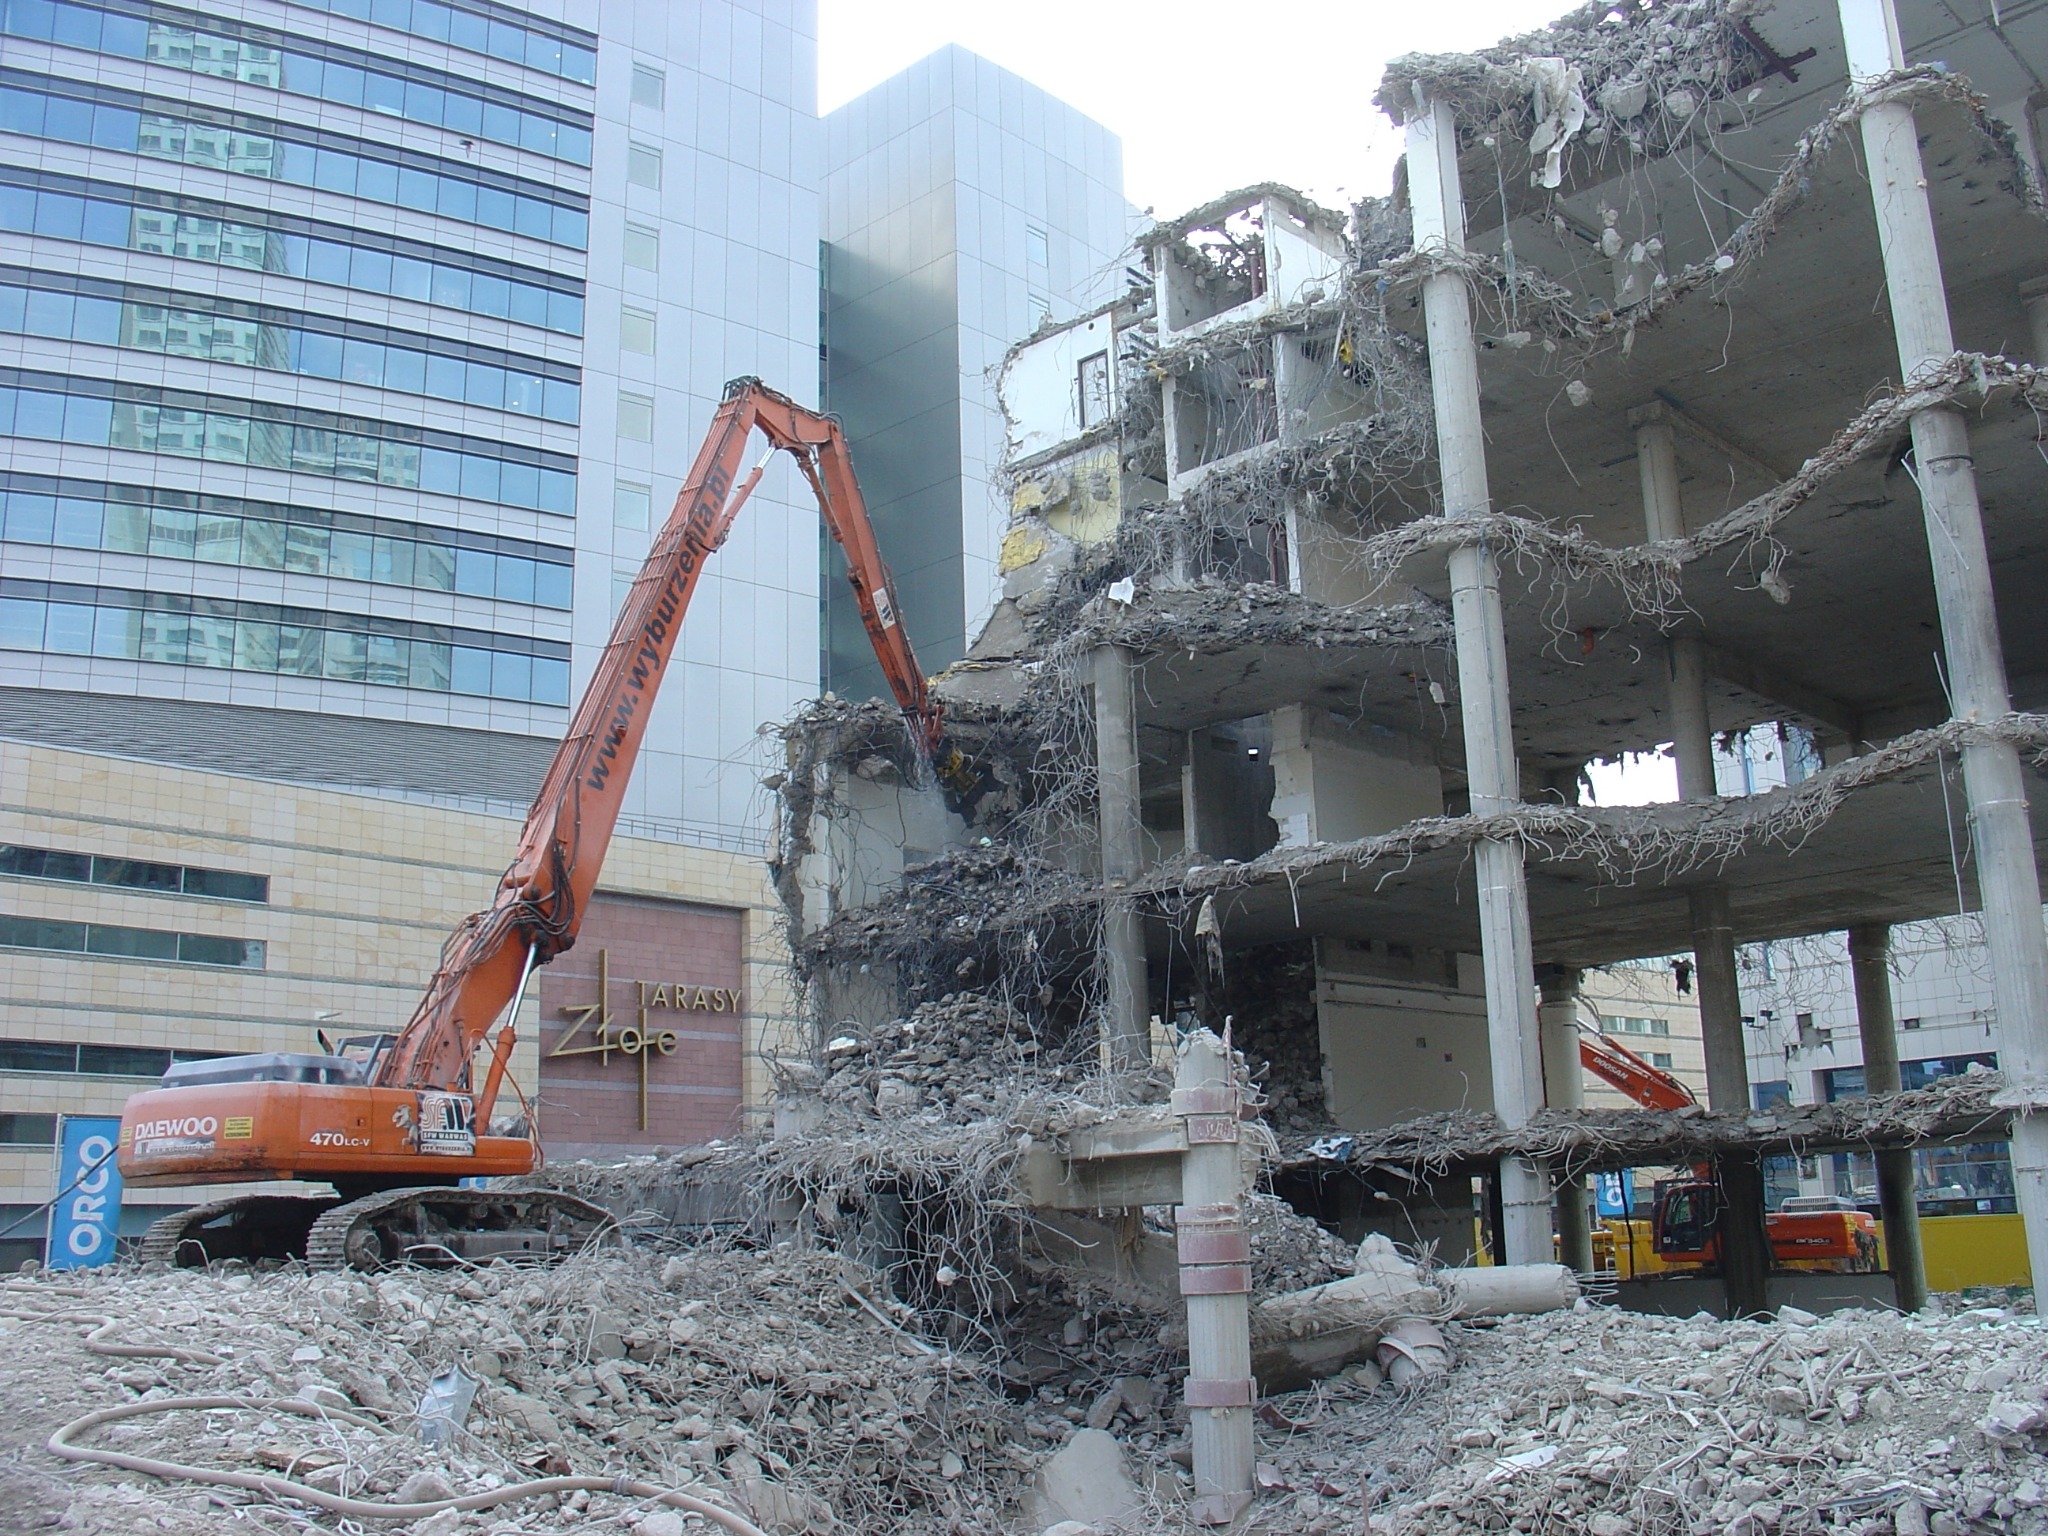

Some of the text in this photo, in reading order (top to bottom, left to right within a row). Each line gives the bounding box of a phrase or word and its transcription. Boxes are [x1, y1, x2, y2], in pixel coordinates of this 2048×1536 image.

[586, 462, 731, 791] www.wyburzenia.pl
[636, 980, 742, 1013] TARASY
[1592, 1056, 1629, 1080] DOOSAN
[134, 1116, 218, 1140] DAEWOO
[68, 1135, 112, 1256] ORCO
